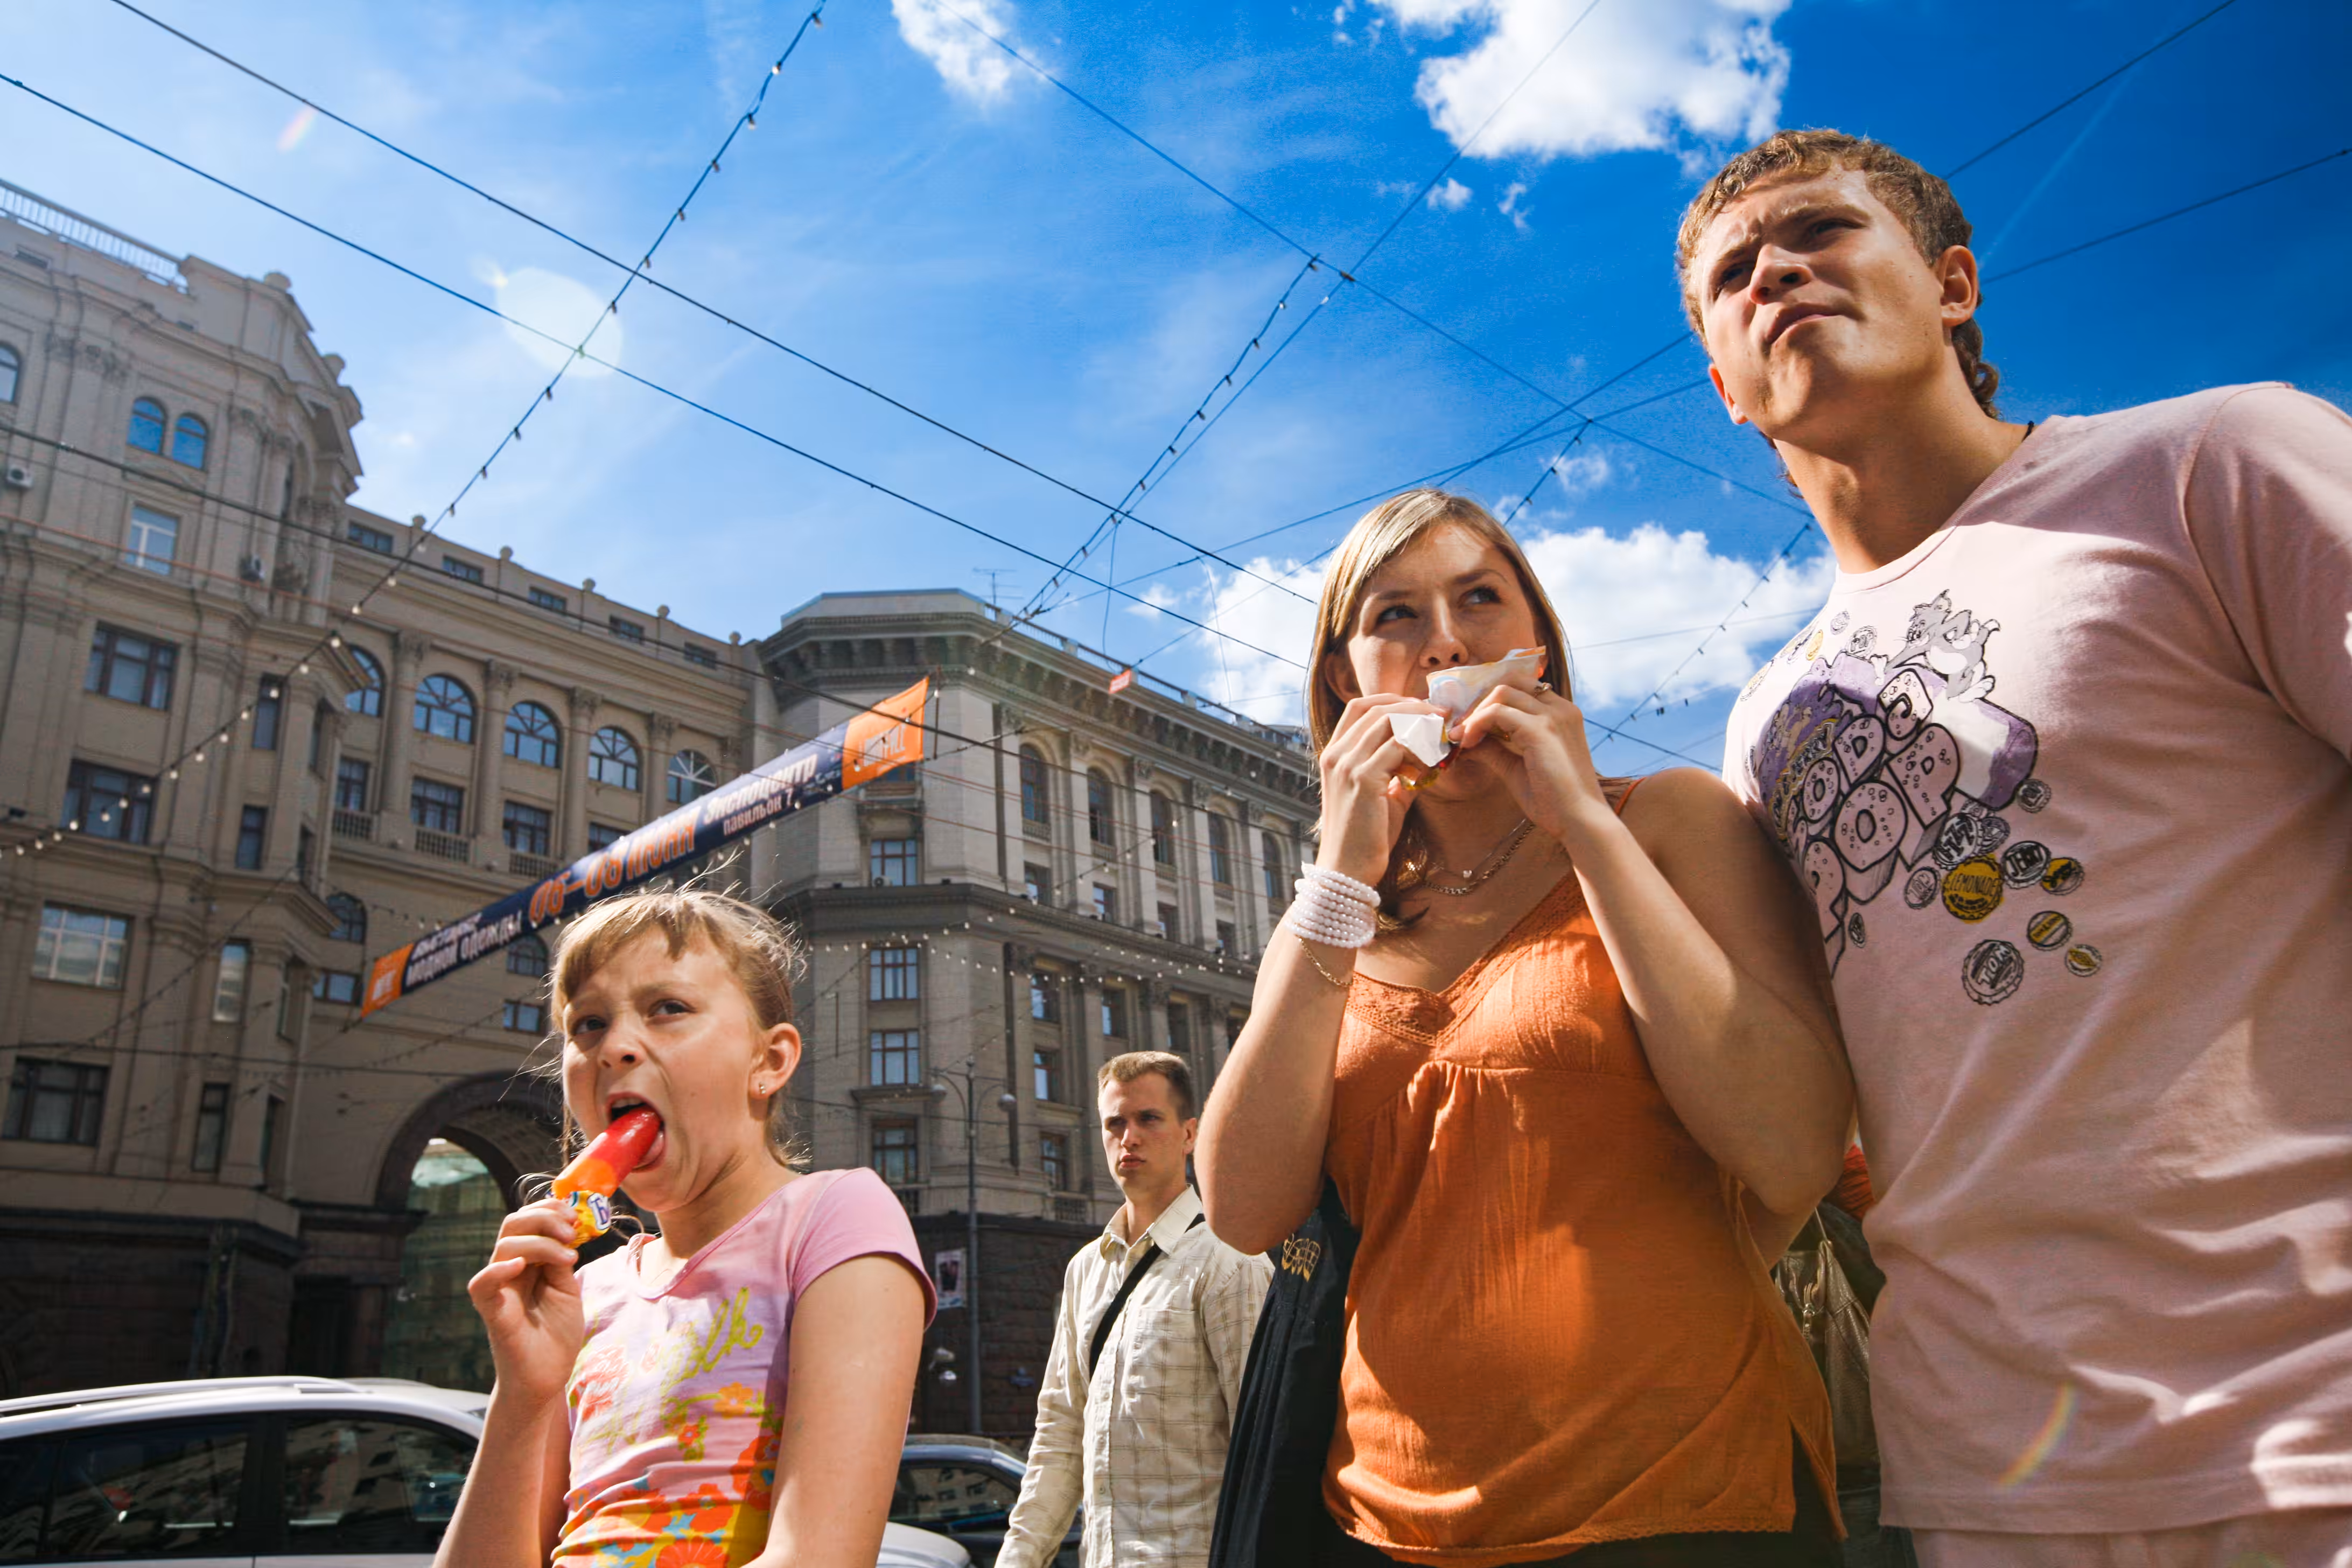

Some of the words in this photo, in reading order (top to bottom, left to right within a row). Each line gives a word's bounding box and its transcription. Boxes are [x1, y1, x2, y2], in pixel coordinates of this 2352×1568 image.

[723, 796, 781, 836] павильон
[785, 788, 793, 806] 7
[1948, 873, 2001, 897] LEMONADE
[1976, 944, 2012, 985] TOM
